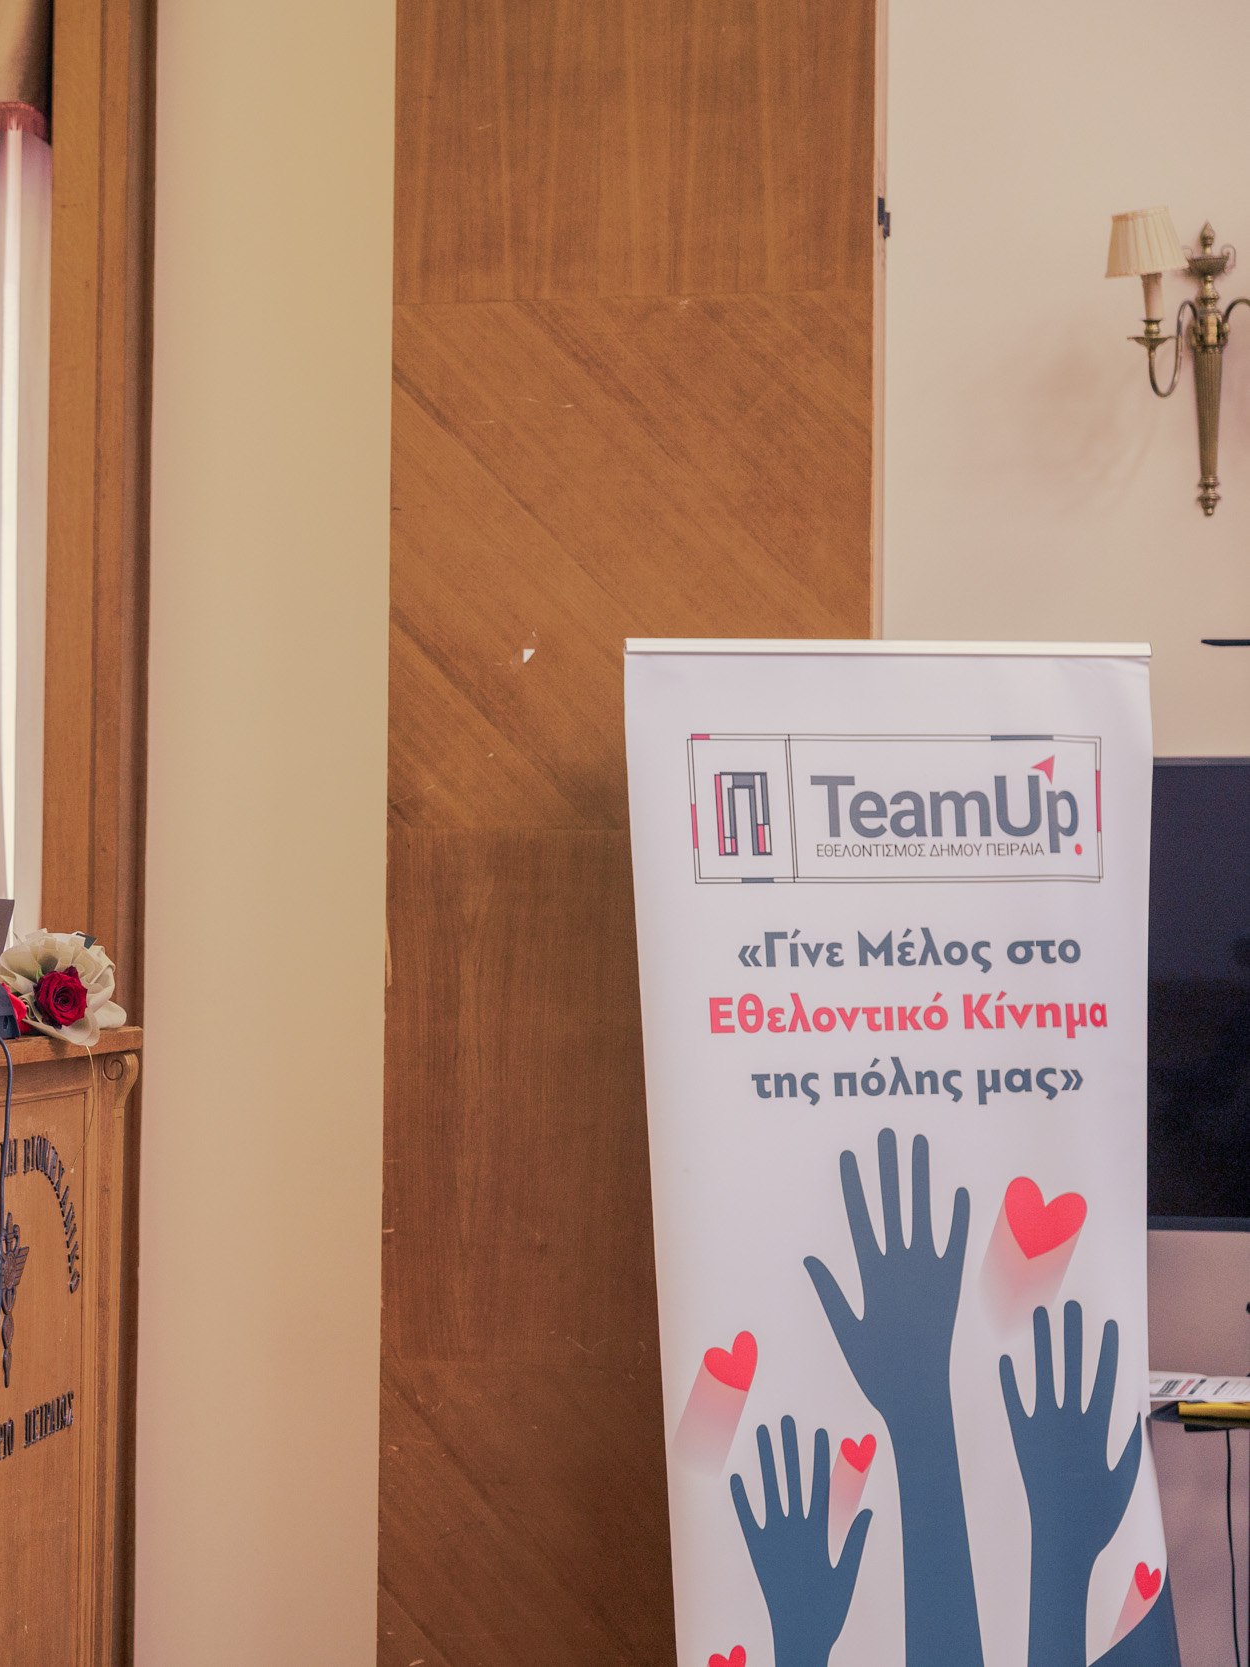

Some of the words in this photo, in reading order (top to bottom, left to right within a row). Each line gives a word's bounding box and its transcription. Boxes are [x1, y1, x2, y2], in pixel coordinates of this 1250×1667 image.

[816, 843, 927, 858] ΕΘΕΛΟΝΤΙΣΜΟΣ
[929, 843, 983, 857] ΔΗΜΟΥ
[985, 842, 1045, 857] ΠΕΙΡΑΙΑ
[737, 929, 845, 969] «Γίνε
[857, 927, 992, 974] Μέλος
[1006, 938, 1081, 966] στο
[709, 992, 949, 1034] Εθελοντικό
[962, 991, 1108, 1039] Κίνημα
[751, 1071, 820, 1106] της
[833, 1056, 963, 1103] πόλης
[976, 1066, 1084, 1106] μας»
